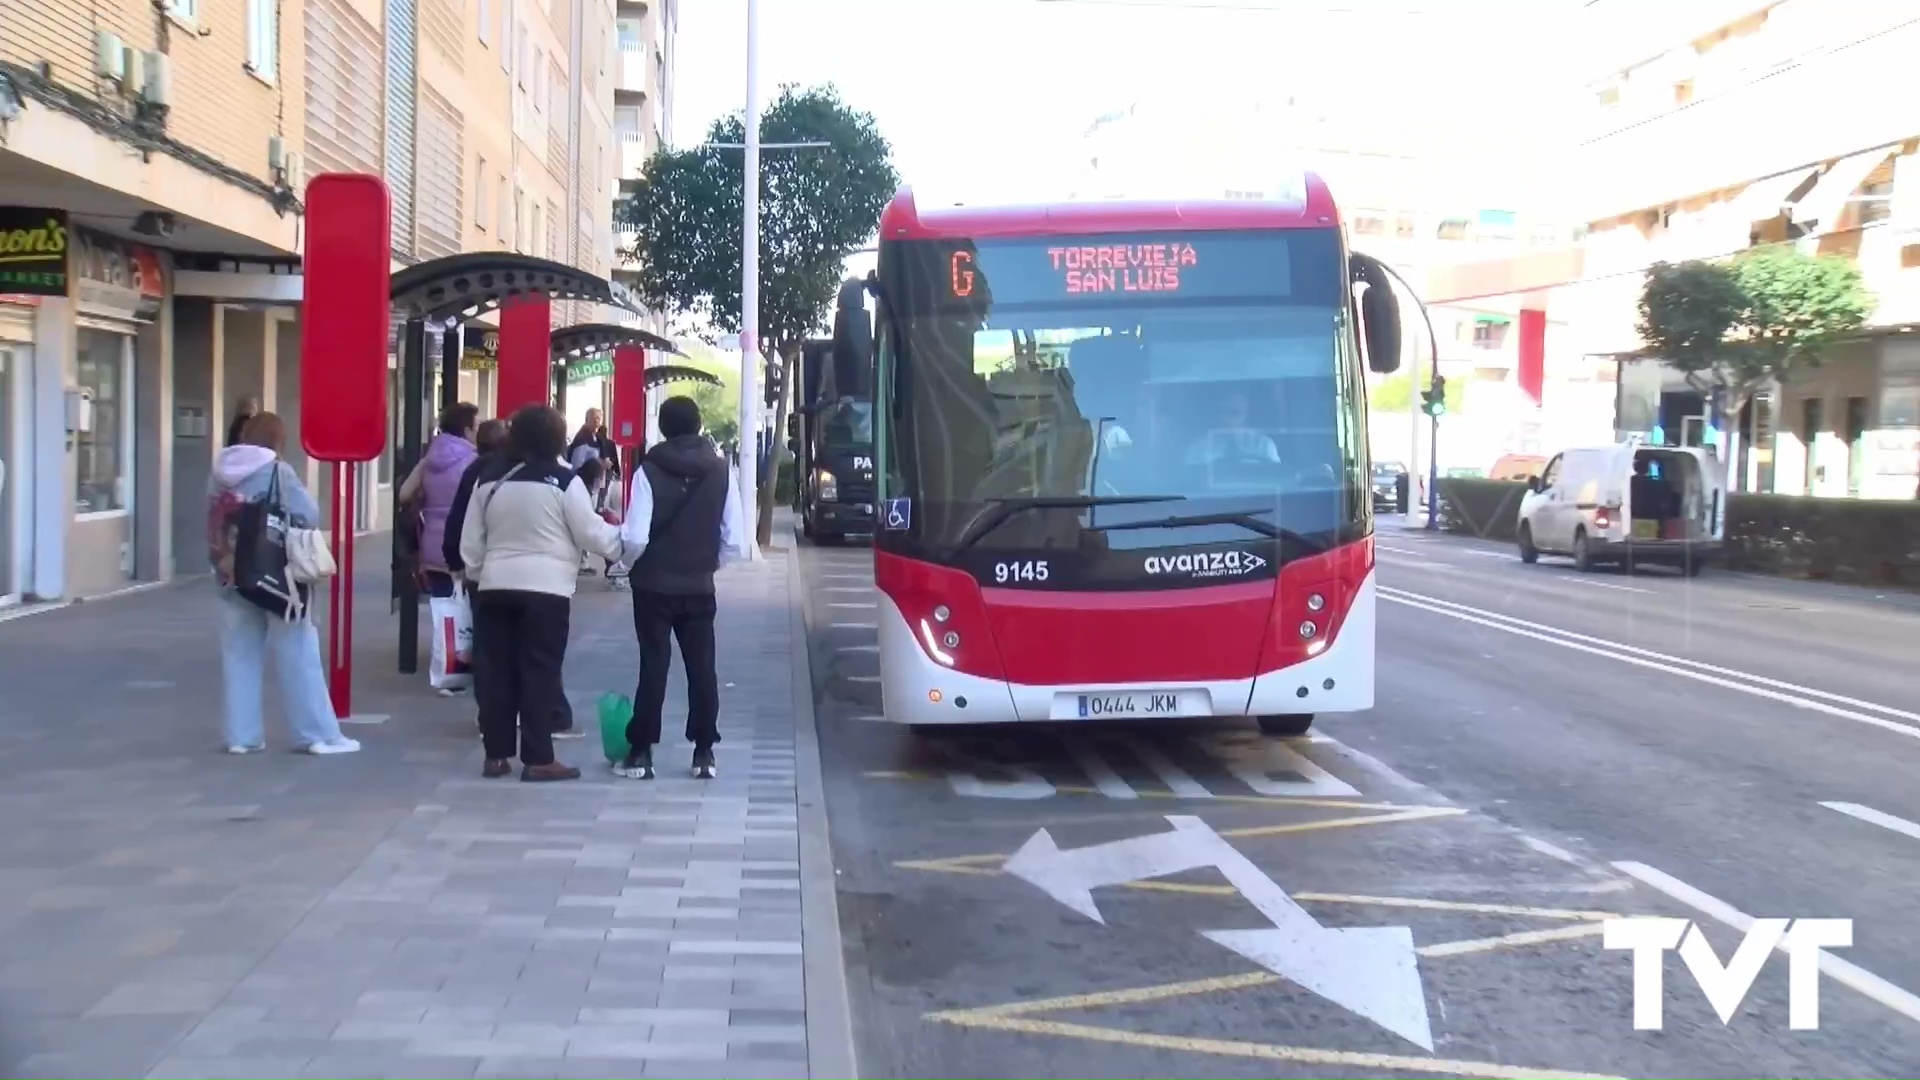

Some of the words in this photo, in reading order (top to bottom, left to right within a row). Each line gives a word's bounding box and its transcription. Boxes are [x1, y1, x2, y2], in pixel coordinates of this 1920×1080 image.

[1048, 243, 1197, 270] TORREVIEJA
[952, 250, 973, 297] G
[1066, 269, 1116, 292] SAN
[1124, 265, 1179, 292] LUIS
[995, 560, 1049, 583] 9145
[1144, 550, 1241, 575] avanza
[1091, 697, 1135, 714] 0444
[1145, 694, 1177, 713] JKM
